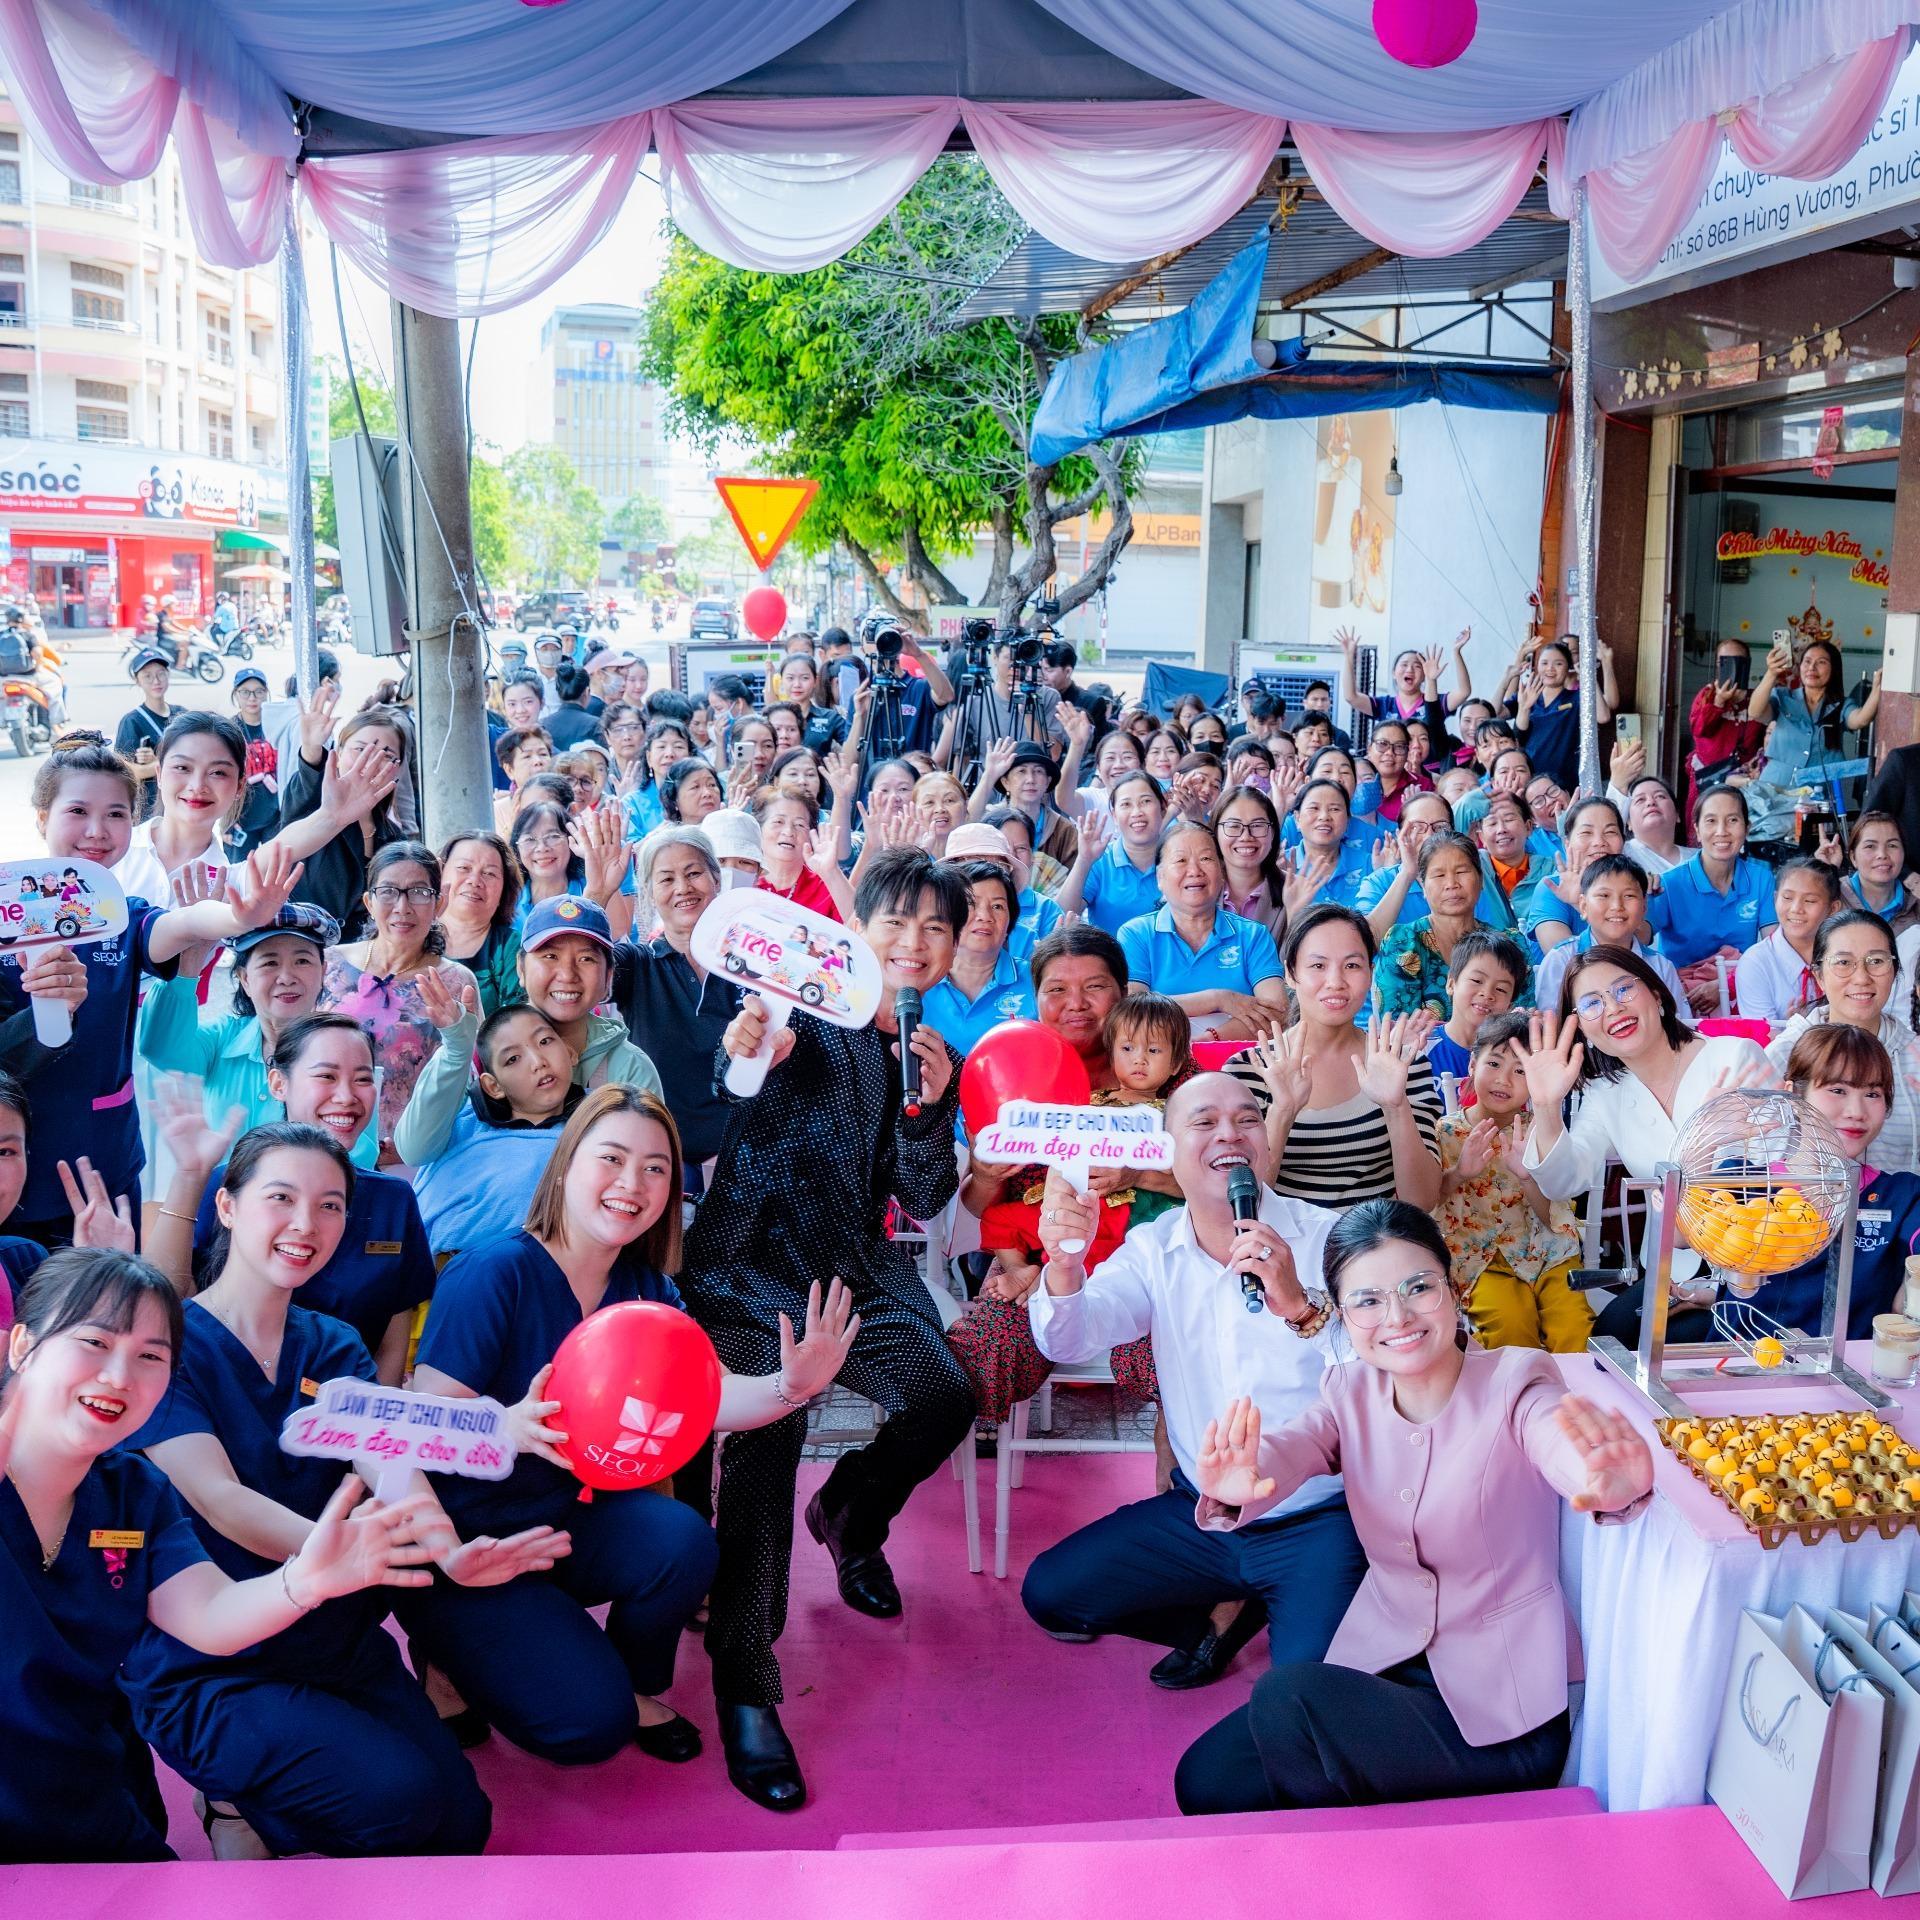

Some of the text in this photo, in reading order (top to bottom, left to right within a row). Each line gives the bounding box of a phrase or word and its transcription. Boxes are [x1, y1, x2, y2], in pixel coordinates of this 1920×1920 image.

[1687, 224, 1704, 255] số
[1707, 217, 1738, 248] 86B
[1743, 202, 1790, 237] Hùng
[1077, 1113, 1105, 1131] CHO
[987, 1132, 1037, 1154] Làm
[1044, 1135, 1080, 1161] đẹp
[1089, 1137, 1124, 1158] cho
[408, 1403, 445, 1427] CHO
[416, 1434, 458, 1462] cho
